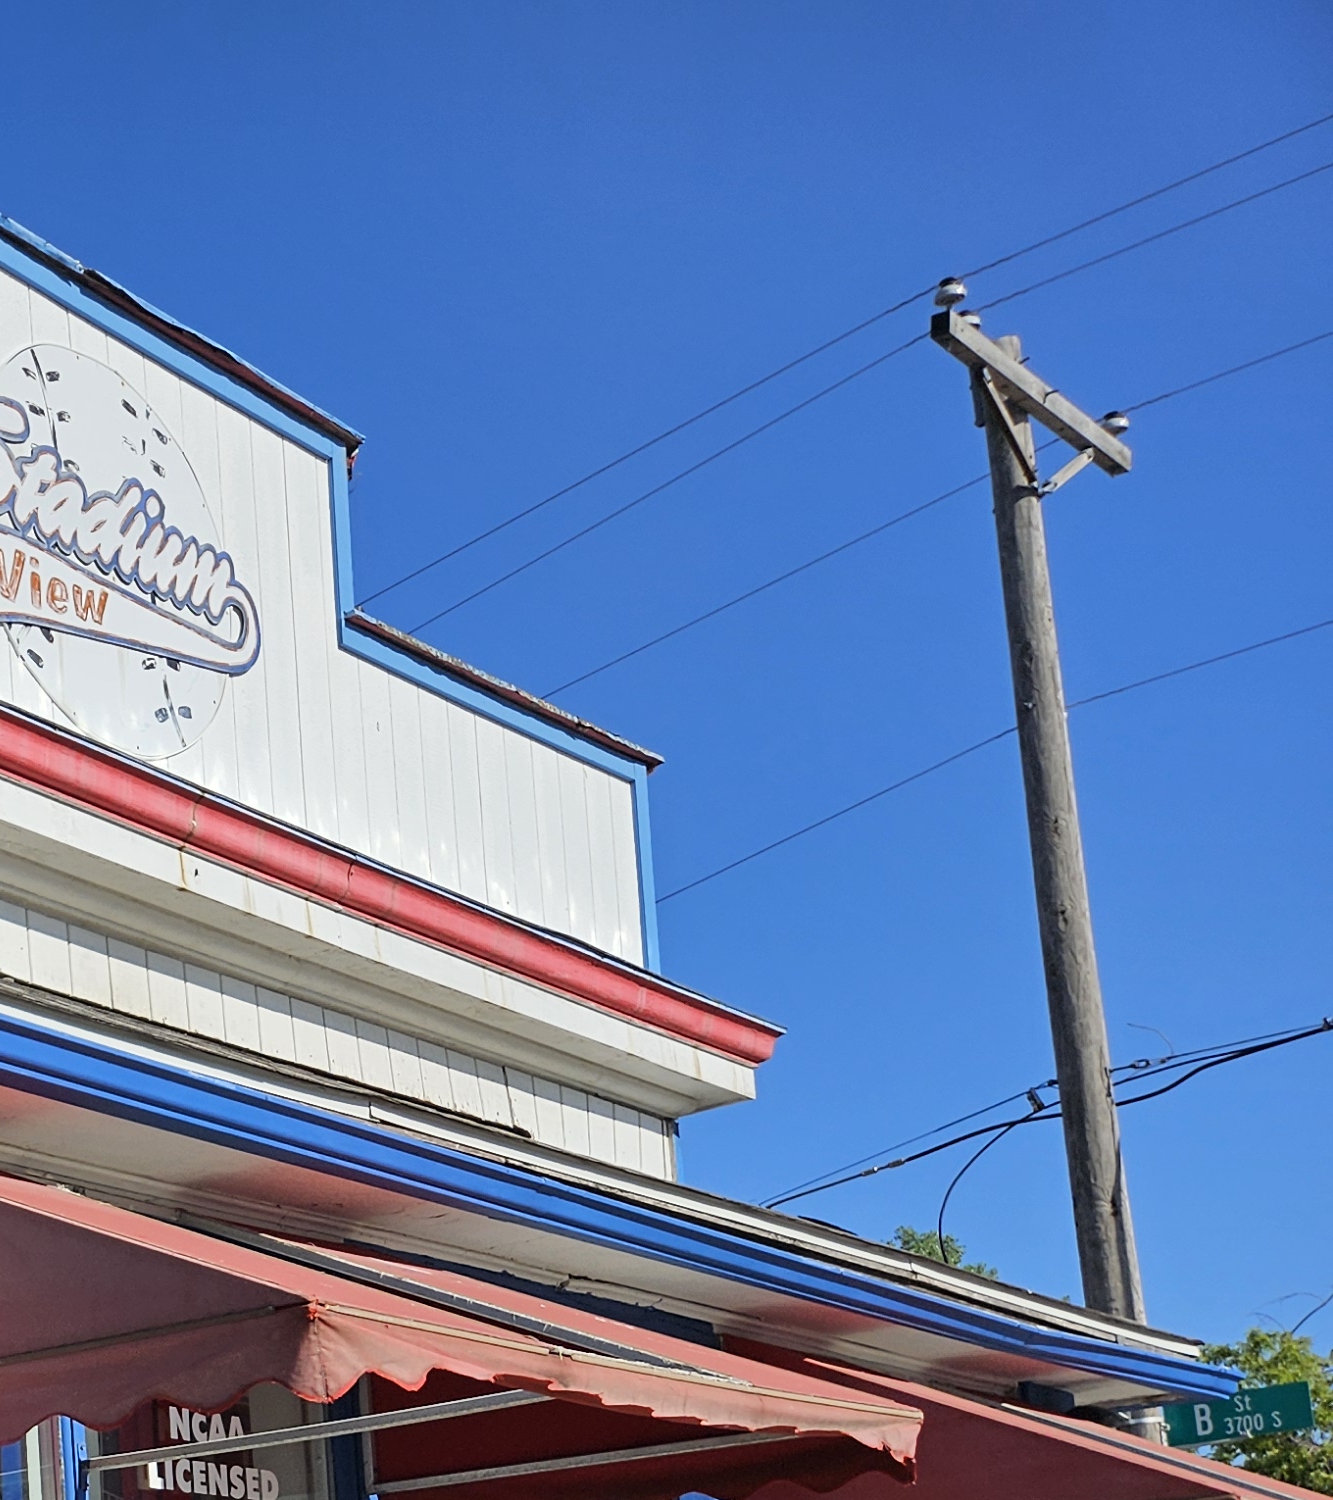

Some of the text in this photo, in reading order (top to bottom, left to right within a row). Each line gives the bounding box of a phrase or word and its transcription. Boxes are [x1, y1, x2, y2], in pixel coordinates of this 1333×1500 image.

[169, 1405, 244, 1443] NCAA
[1193, 1394, 1252, 1437] B St
[1224, 1410, 1283, 1437] 3700 S
